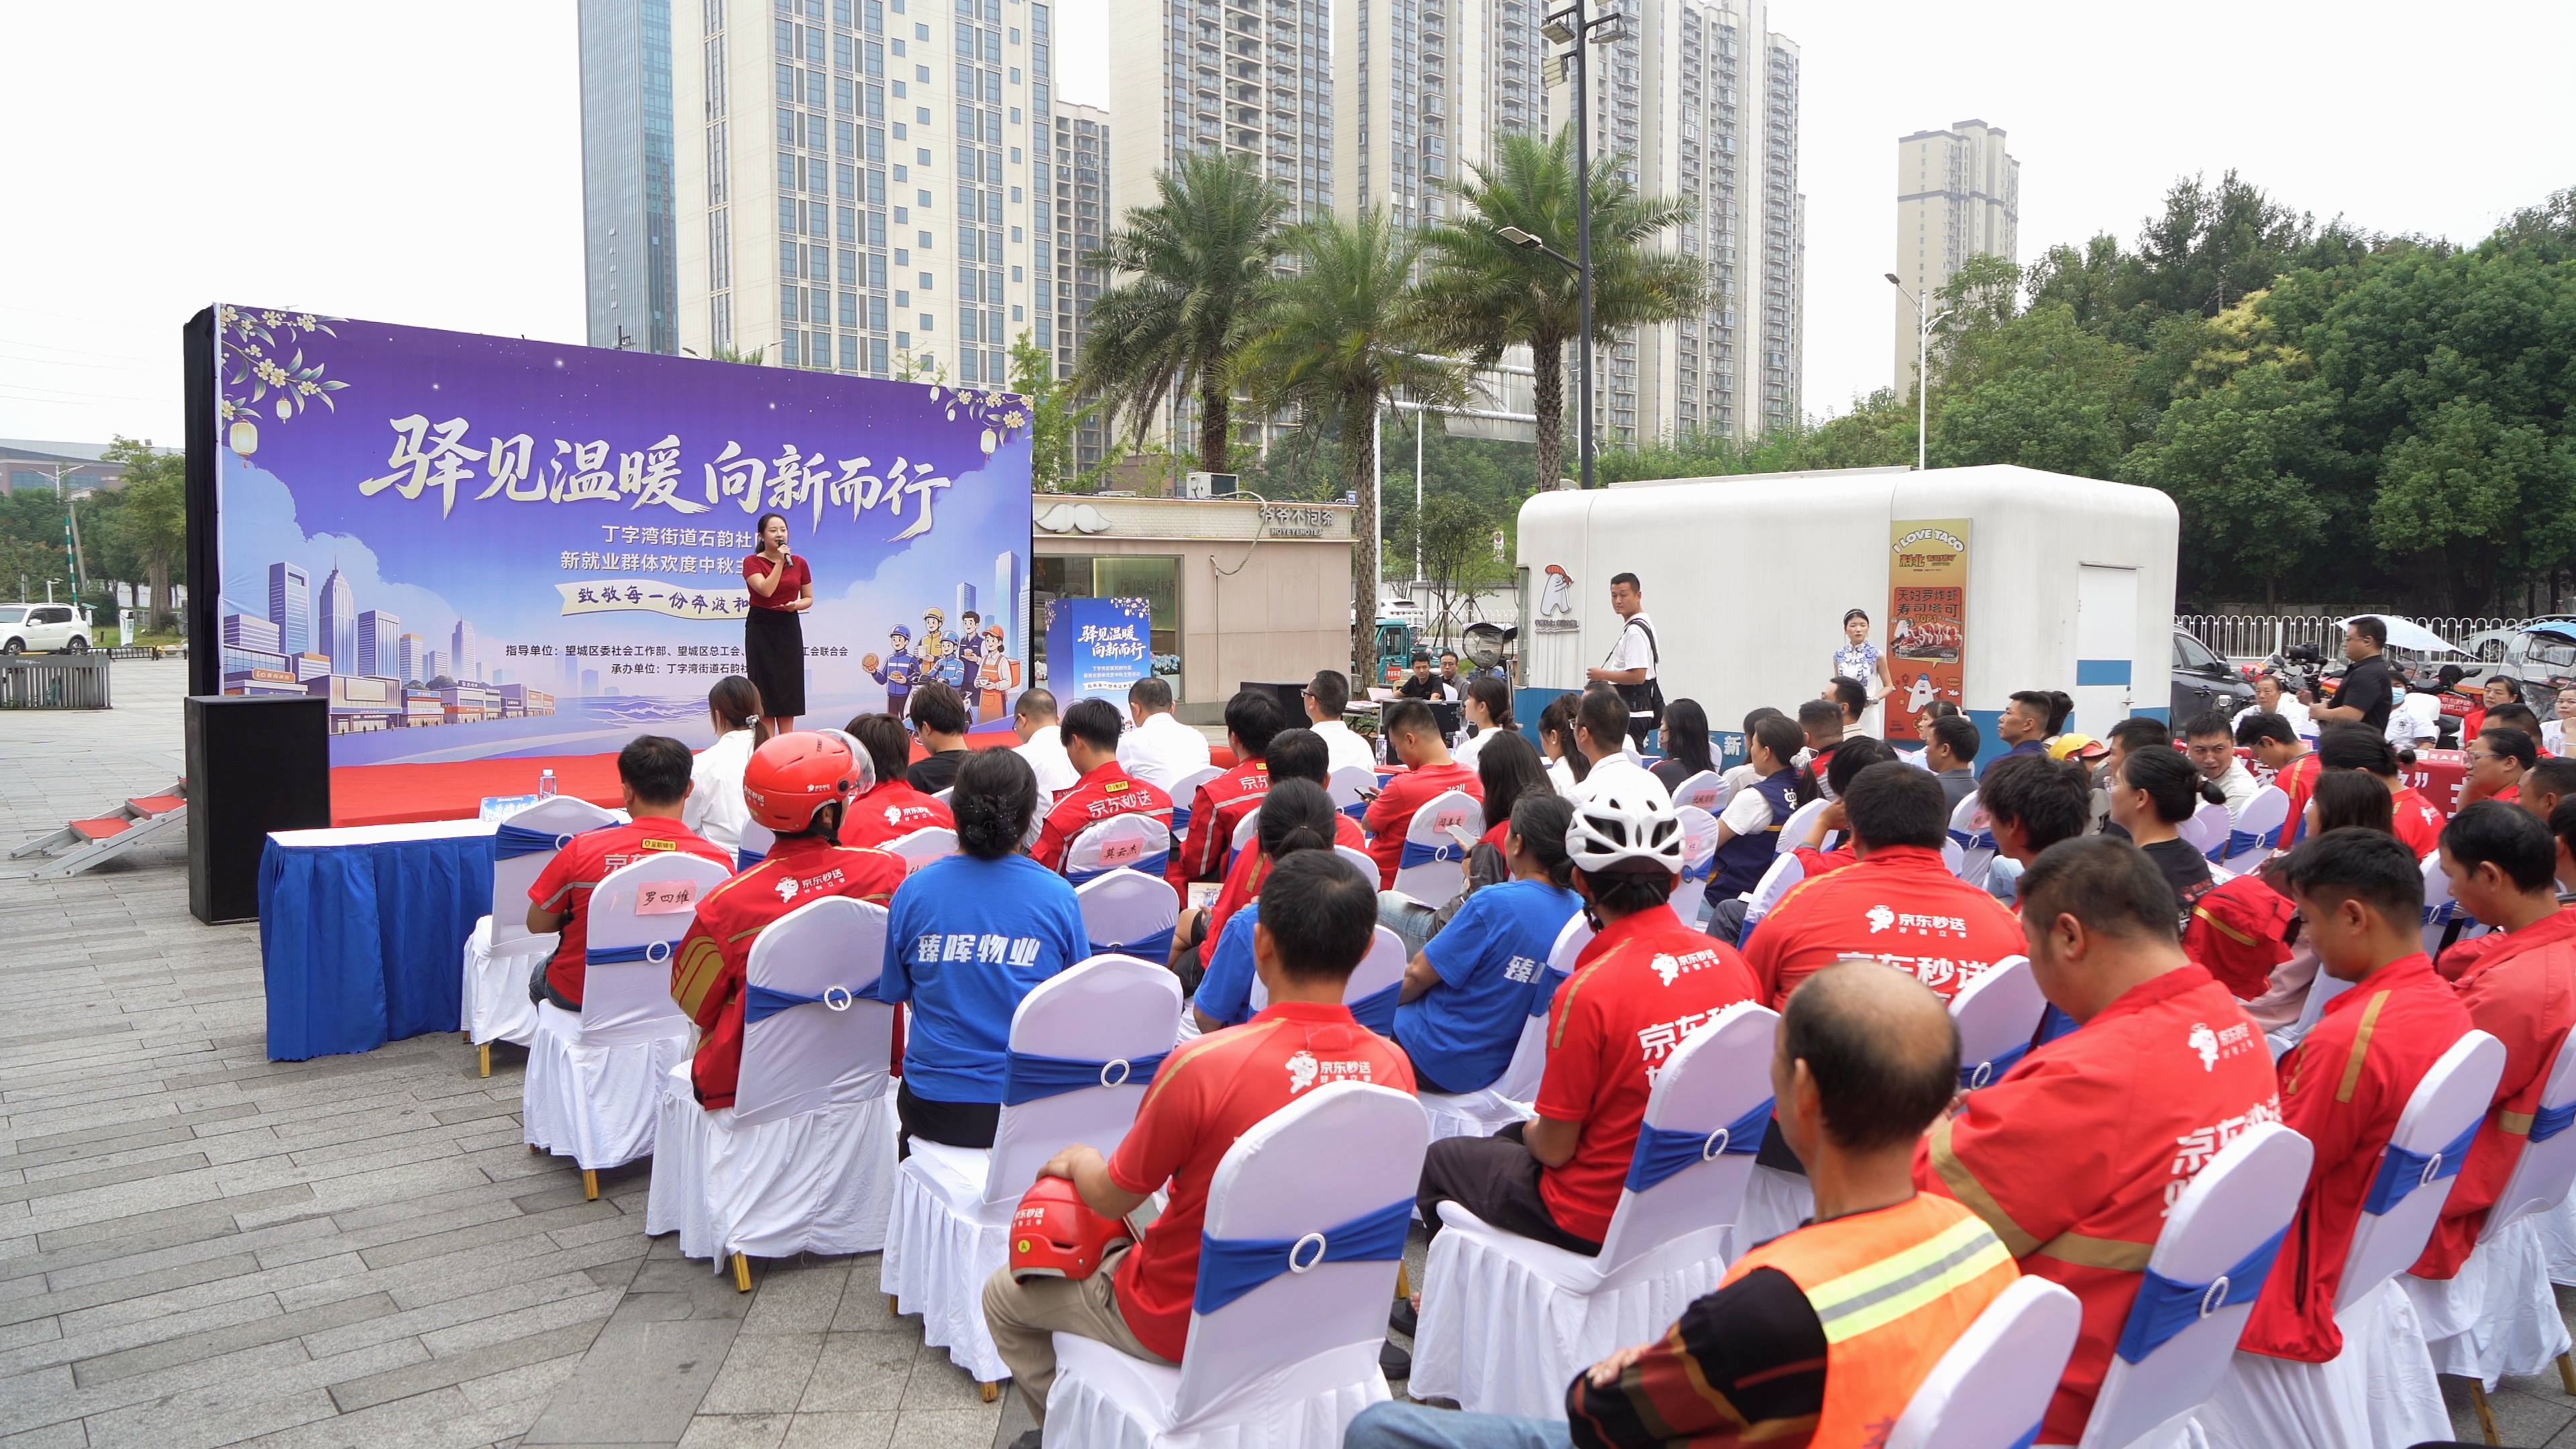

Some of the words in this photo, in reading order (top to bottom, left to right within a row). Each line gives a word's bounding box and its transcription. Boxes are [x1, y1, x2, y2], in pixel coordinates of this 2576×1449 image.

[358, 414, 713, 521] 驿见温暖
[704, 440, 951, 543] 向新而行
[1259, 507, 1335, 526] 爷爷不泡茶
[601, 525, 760, 549] 丁字湾街道石韵社
[1892, 543, 1901, 553] I
[1899, 529, 1932, 547] LOVE
[1935, 529, 1964, 553] TACO
[1897, 589, 1958, 602] 天妇罗炸虾
[1897, 603, 1958, 618] 寿司塔可
[1916, 614, 1937, 623] TOP1
[1077, 624, 1140, 645] 驿见温暖
[1092, 641, 1146, 662] 向新而行
[1723, 735, 1741, 756] 新
[1085, 790, 1152, 818] 京东秒送
[802, 868, 844, 889] 京东秒送
[643, 889, 690, 906] 罗四维
[1898, 913, 1966, 931] 京东秒送
[918, 934, 1040, 967] 臻晖物业
[1677, 949, 1717, 967] 京东秒送
[1320, 1061, 1371, 1074] 京东秒送
[1021, 1242, 1027, 1250] A
